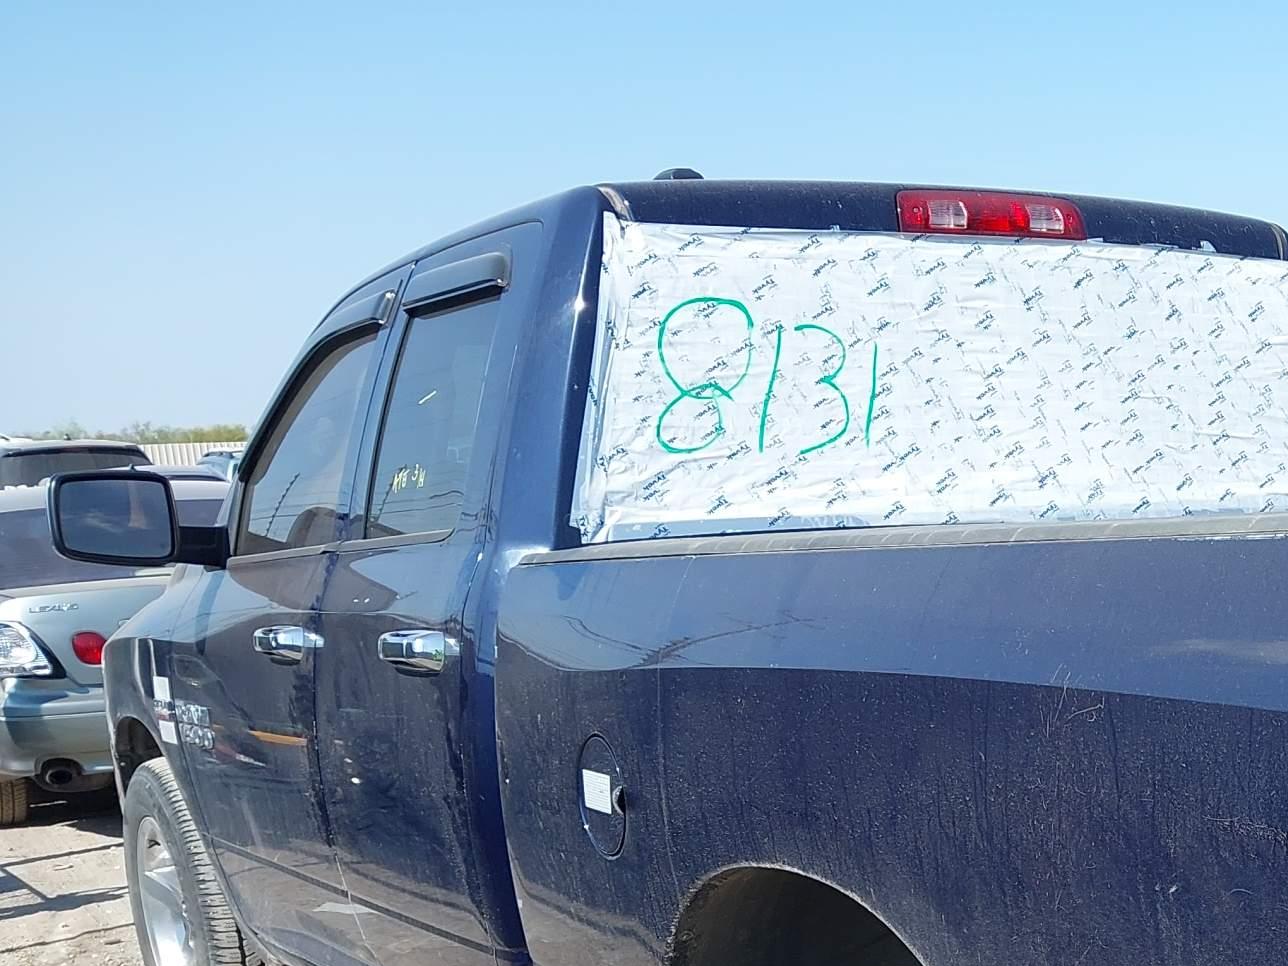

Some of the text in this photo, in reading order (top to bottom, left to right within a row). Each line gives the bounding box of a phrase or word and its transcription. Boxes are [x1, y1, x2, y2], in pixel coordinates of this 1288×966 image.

[678, 236, 702, 251] Tyvek
[799, 238, 821, 253] Tyvek
[751, 278, 776, 294] Tyvek
[812, 306, 833, 320] Tyvek
[656, 296, 878, 454] 8131
[899, 446, 920, 462] Tyvek
[643, 474, 666, 491] Tyvek
[766, 469, 789, 486] Tyvek
[883, 504, 905, 520] Tyvek
